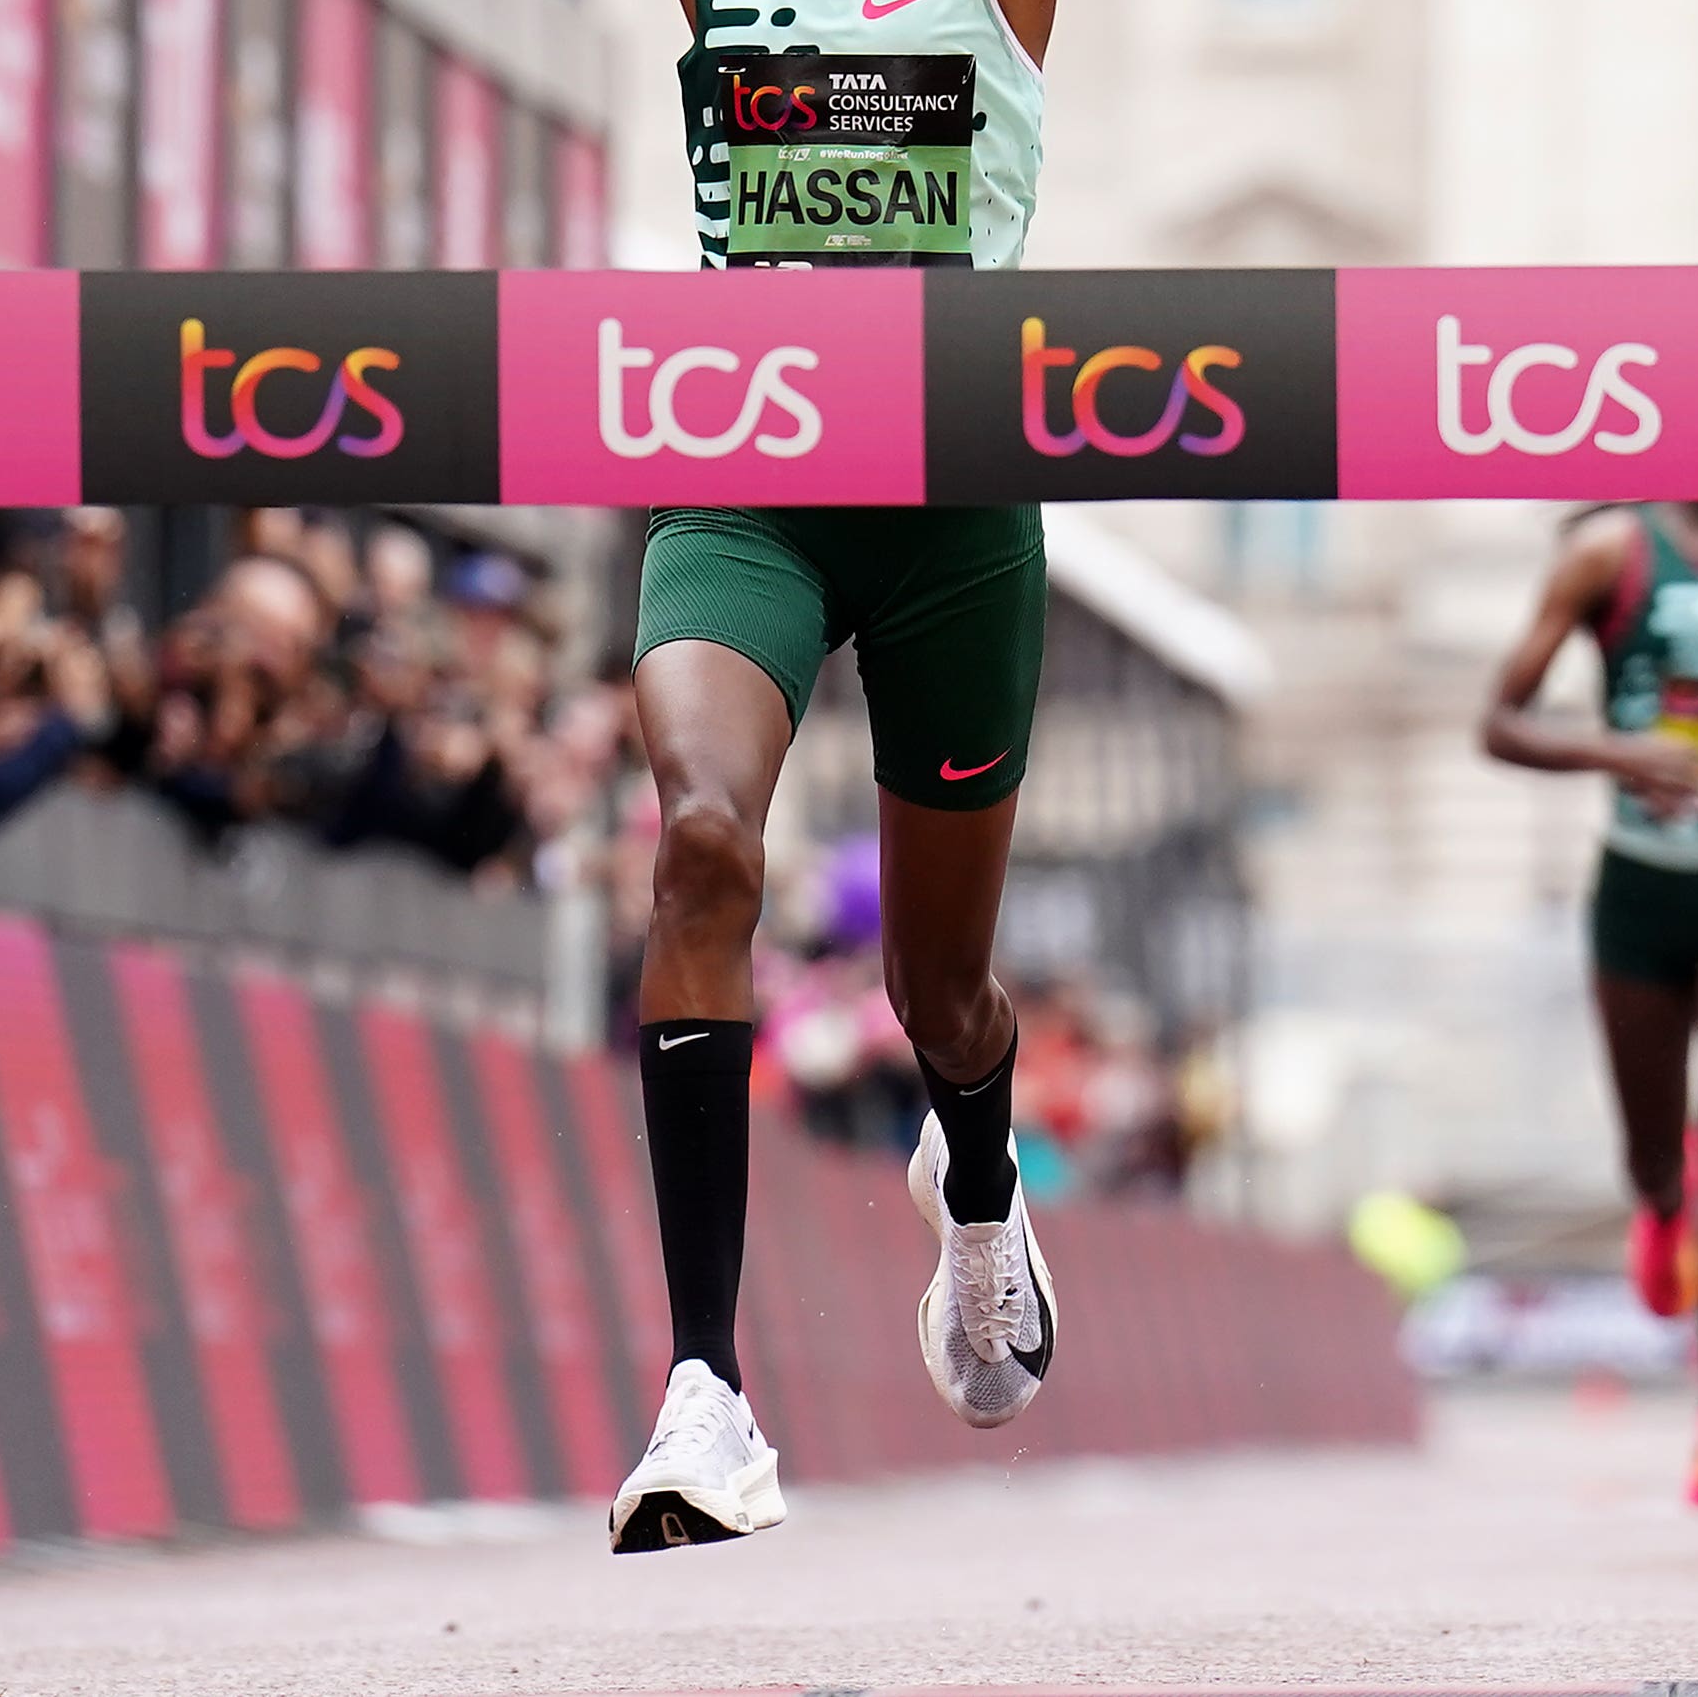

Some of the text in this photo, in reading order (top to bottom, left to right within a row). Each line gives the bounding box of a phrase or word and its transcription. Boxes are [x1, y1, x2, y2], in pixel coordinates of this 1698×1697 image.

[828, 73, 887, 91] TATA
[733, 74, 817, 132] tcs
[828, 94, 958, 112] CONSULTANCY
[829, 115, 914, 133] SERVICES
[738, 168, 958, 226] HASSAN
[180, 318, 405, 459] tcs
[598, 318, 823, 459] tcs
[1021, 317, 1246, 457] tcs
[1436, 314, 1663, 455] tcs
